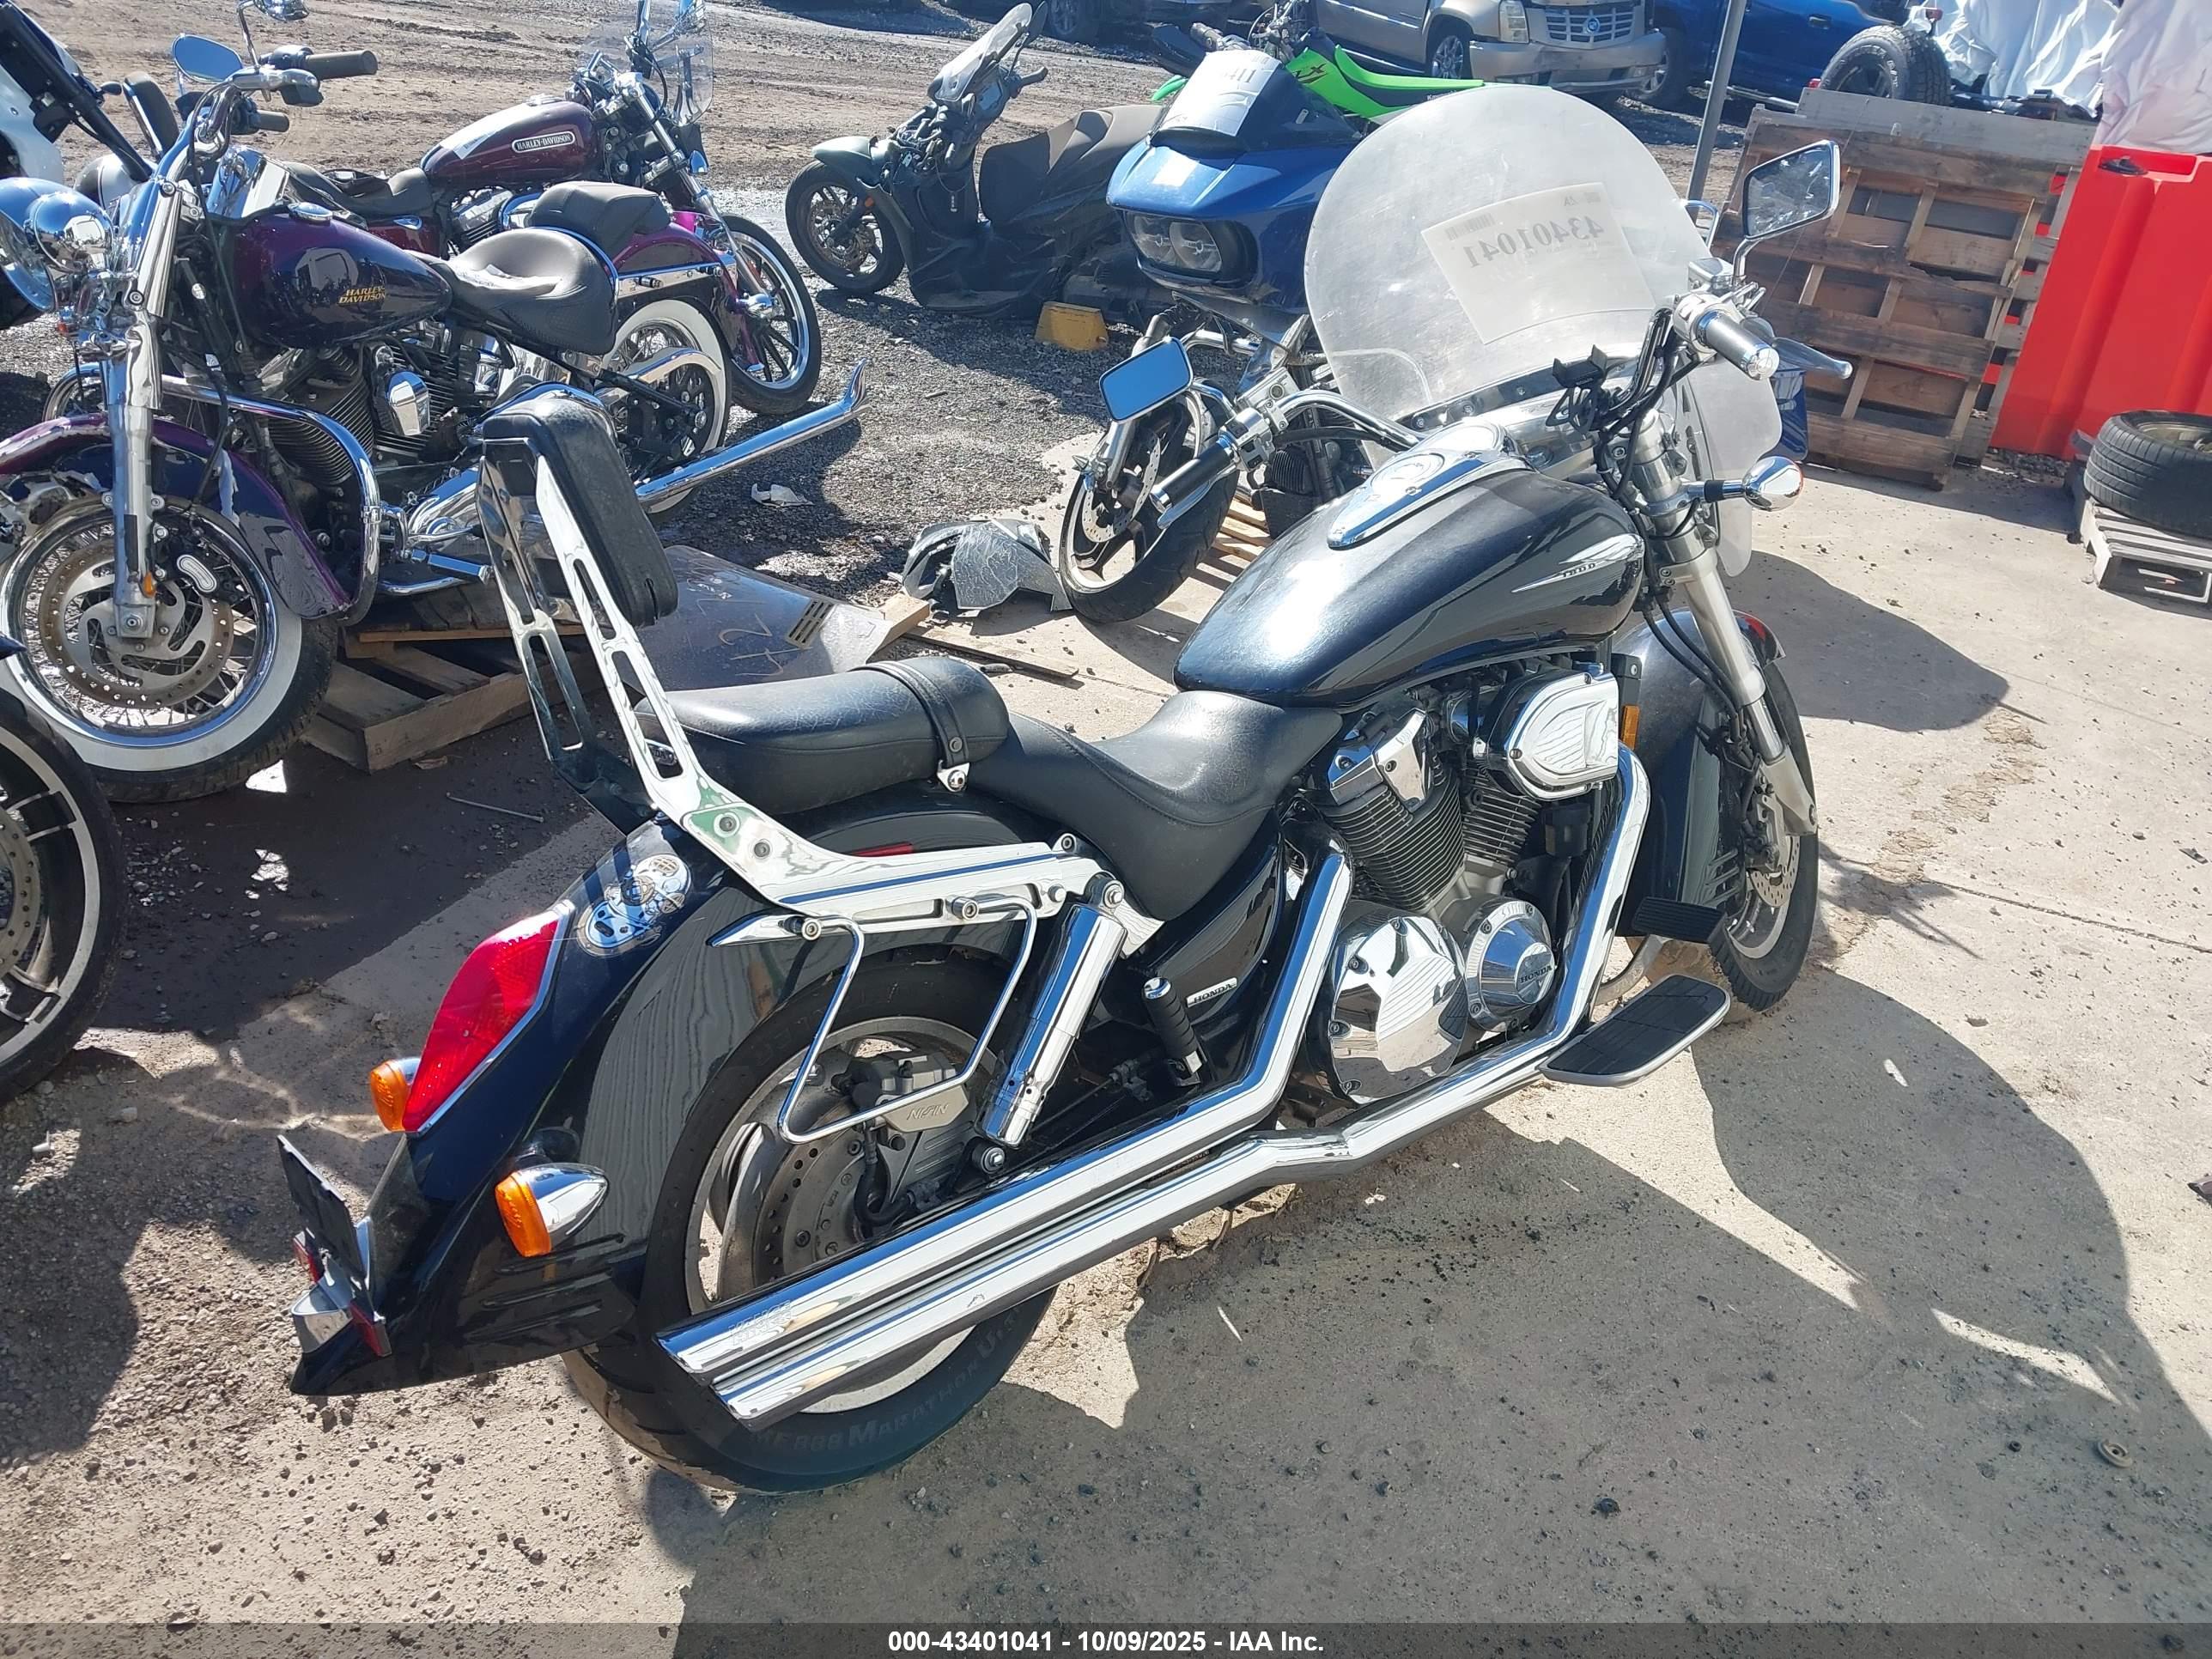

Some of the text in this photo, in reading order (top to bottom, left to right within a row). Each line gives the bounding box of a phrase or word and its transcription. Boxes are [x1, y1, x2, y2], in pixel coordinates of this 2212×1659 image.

[338, 293, 386, 303] DAVIDSON
[1519, 965, 1553, 984] HONDA
[1194, 983, 1233, 1004] HONDA
